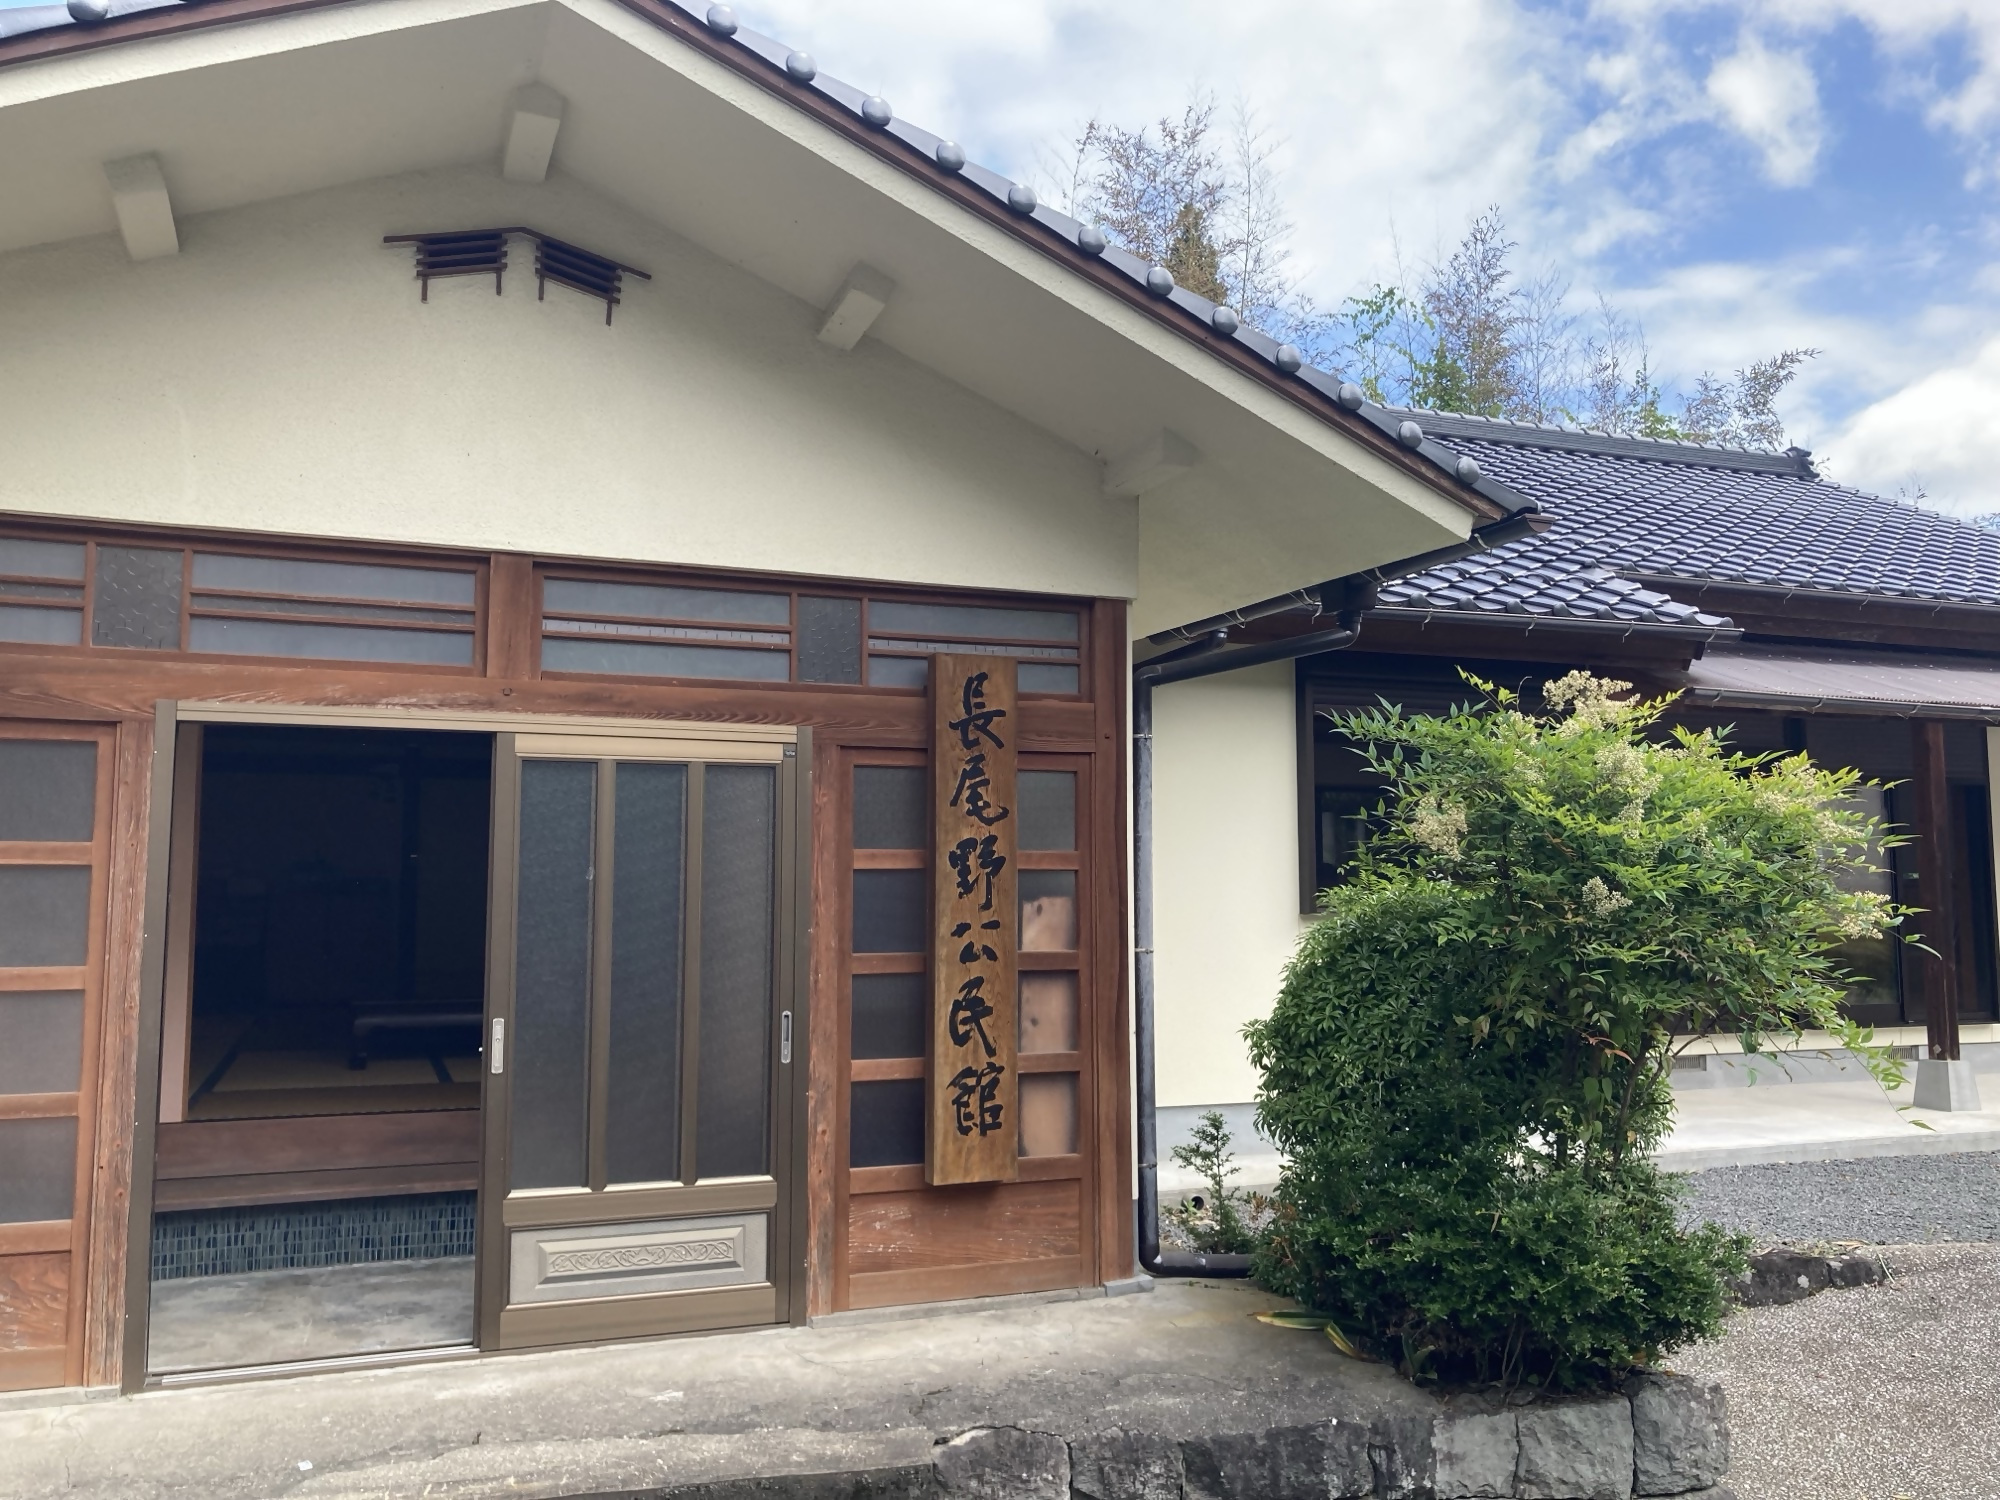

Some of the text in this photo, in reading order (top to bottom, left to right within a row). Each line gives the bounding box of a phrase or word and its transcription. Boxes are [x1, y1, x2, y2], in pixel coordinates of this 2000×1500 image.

[946, 671, 1010, 1137] 長尾野公民館
